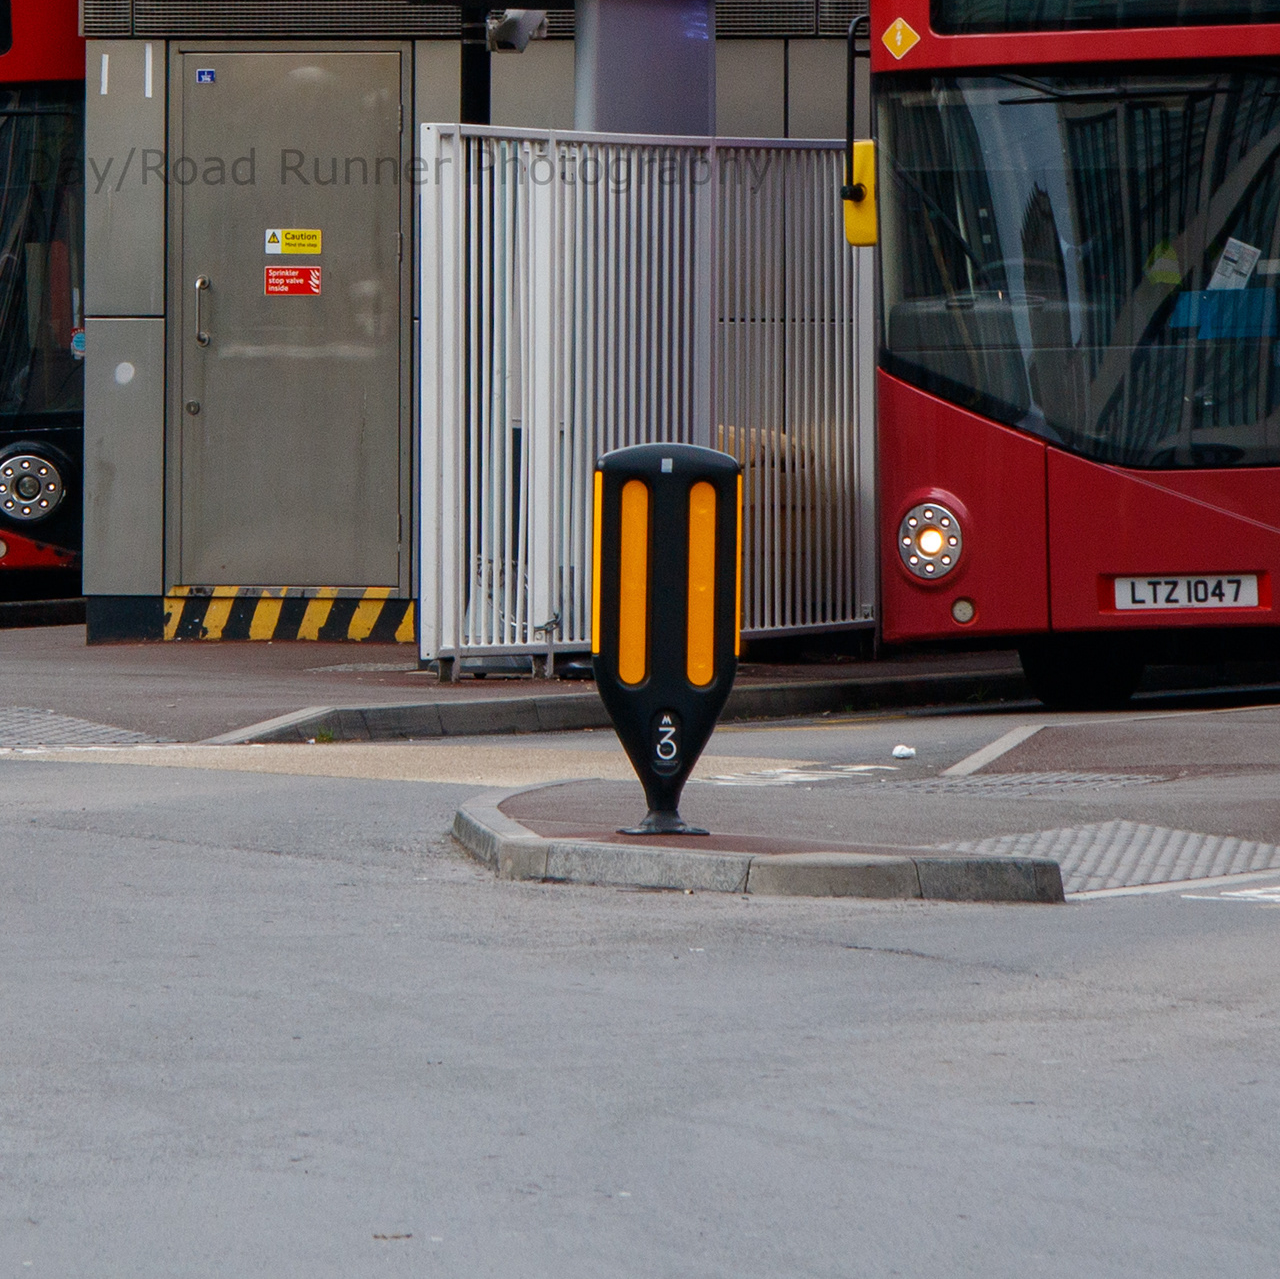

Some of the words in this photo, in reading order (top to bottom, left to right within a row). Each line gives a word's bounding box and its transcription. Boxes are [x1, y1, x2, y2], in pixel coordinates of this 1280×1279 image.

[284, 232, 317, 240] Caution
[268, 269, 299, 277] Sprinkler
[1131, 580, 1179, 604] LTZ
[1187, 578, 1242, 603] 1047
[656, 727, 677, 760] 3
